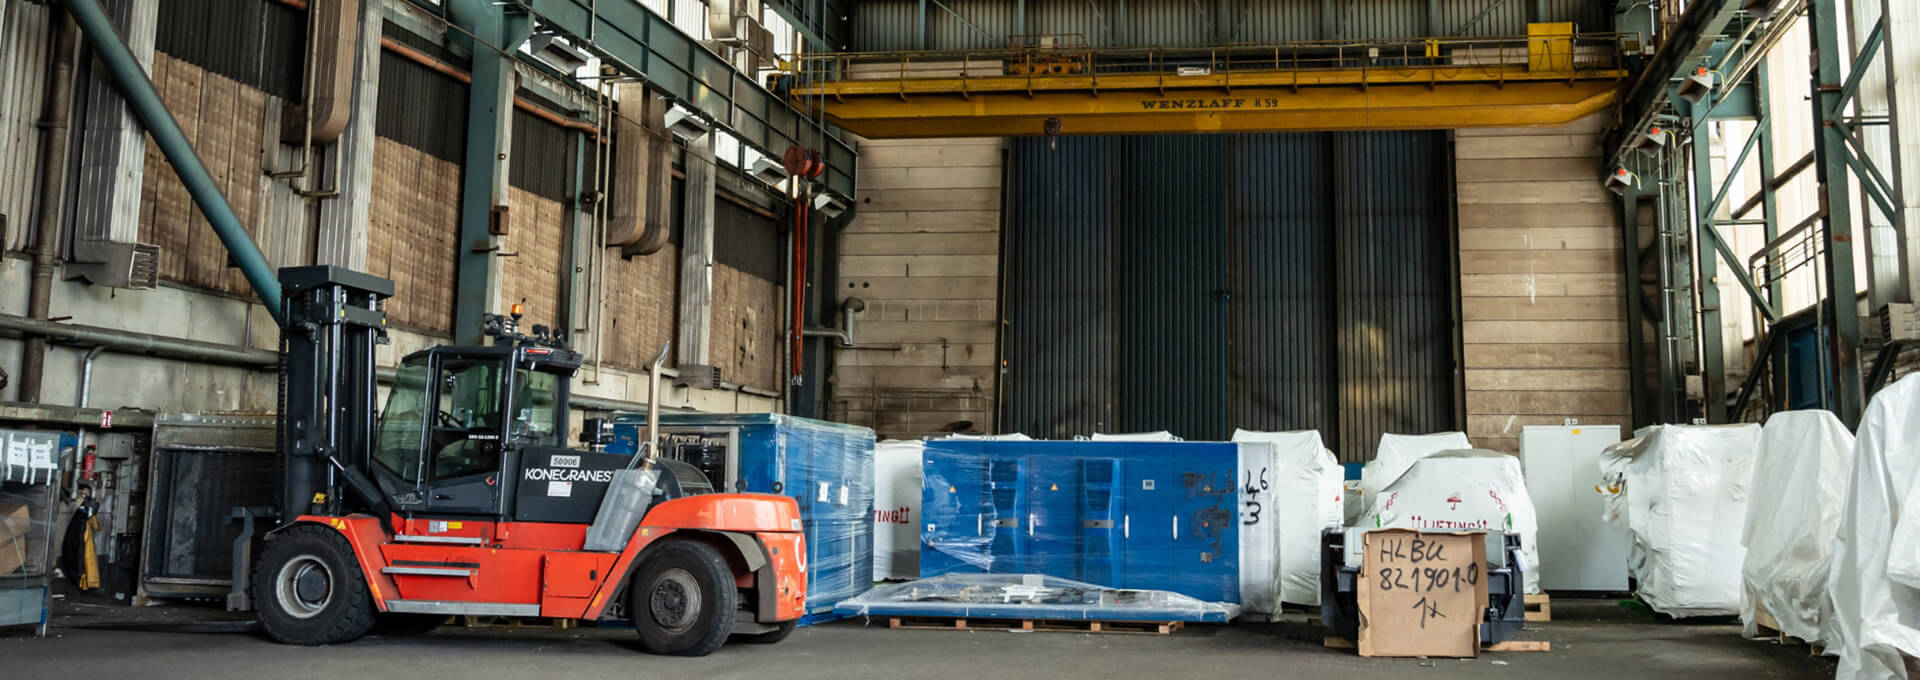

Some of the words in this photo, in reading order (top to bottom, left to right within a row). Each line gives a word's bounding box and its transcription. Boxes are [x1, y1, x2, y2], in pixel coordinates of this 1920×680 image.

[1141, 99, 1245, 110] WENZLAFF
[553, 457, 577, 467] 50006
[525, 468, 611, 482] KONECRANES
